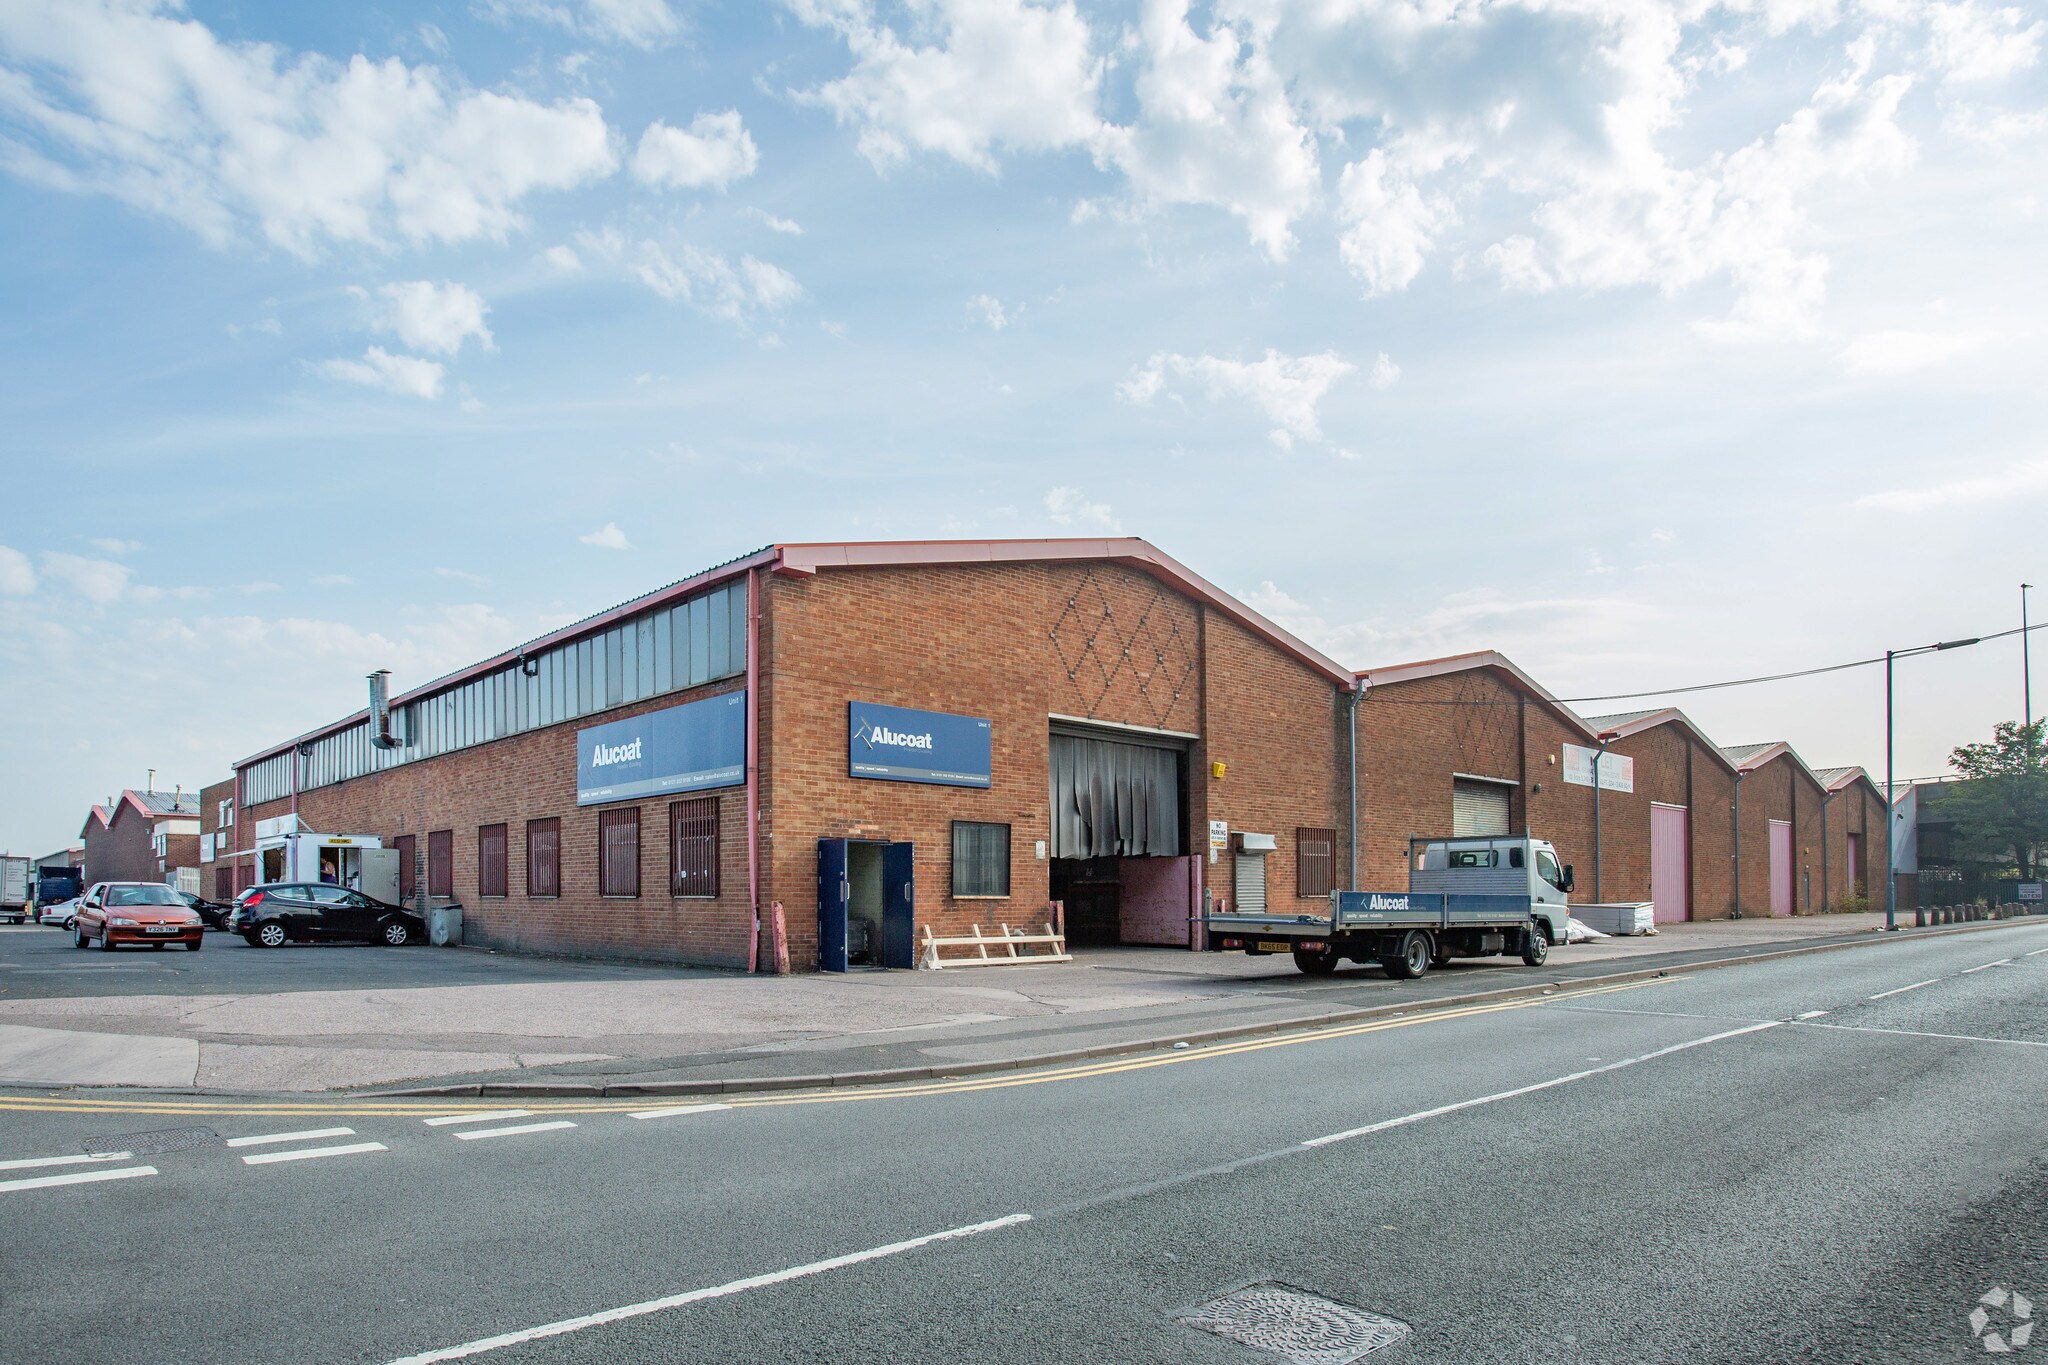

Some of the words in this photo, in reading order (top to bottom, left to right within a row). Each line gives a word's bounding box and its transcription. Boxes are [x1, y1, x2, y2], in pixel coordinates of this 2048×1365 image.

[728, 697, 738, 706] Unit
[871, 726, 932, 749] Alucoat
[592, 737, 642, 768] Alucoat
[1601, 755, 1613, 769] LET
[1369, 894, 1409, 910] Alucoat
[1260, 942, 1276, 950] BK65
